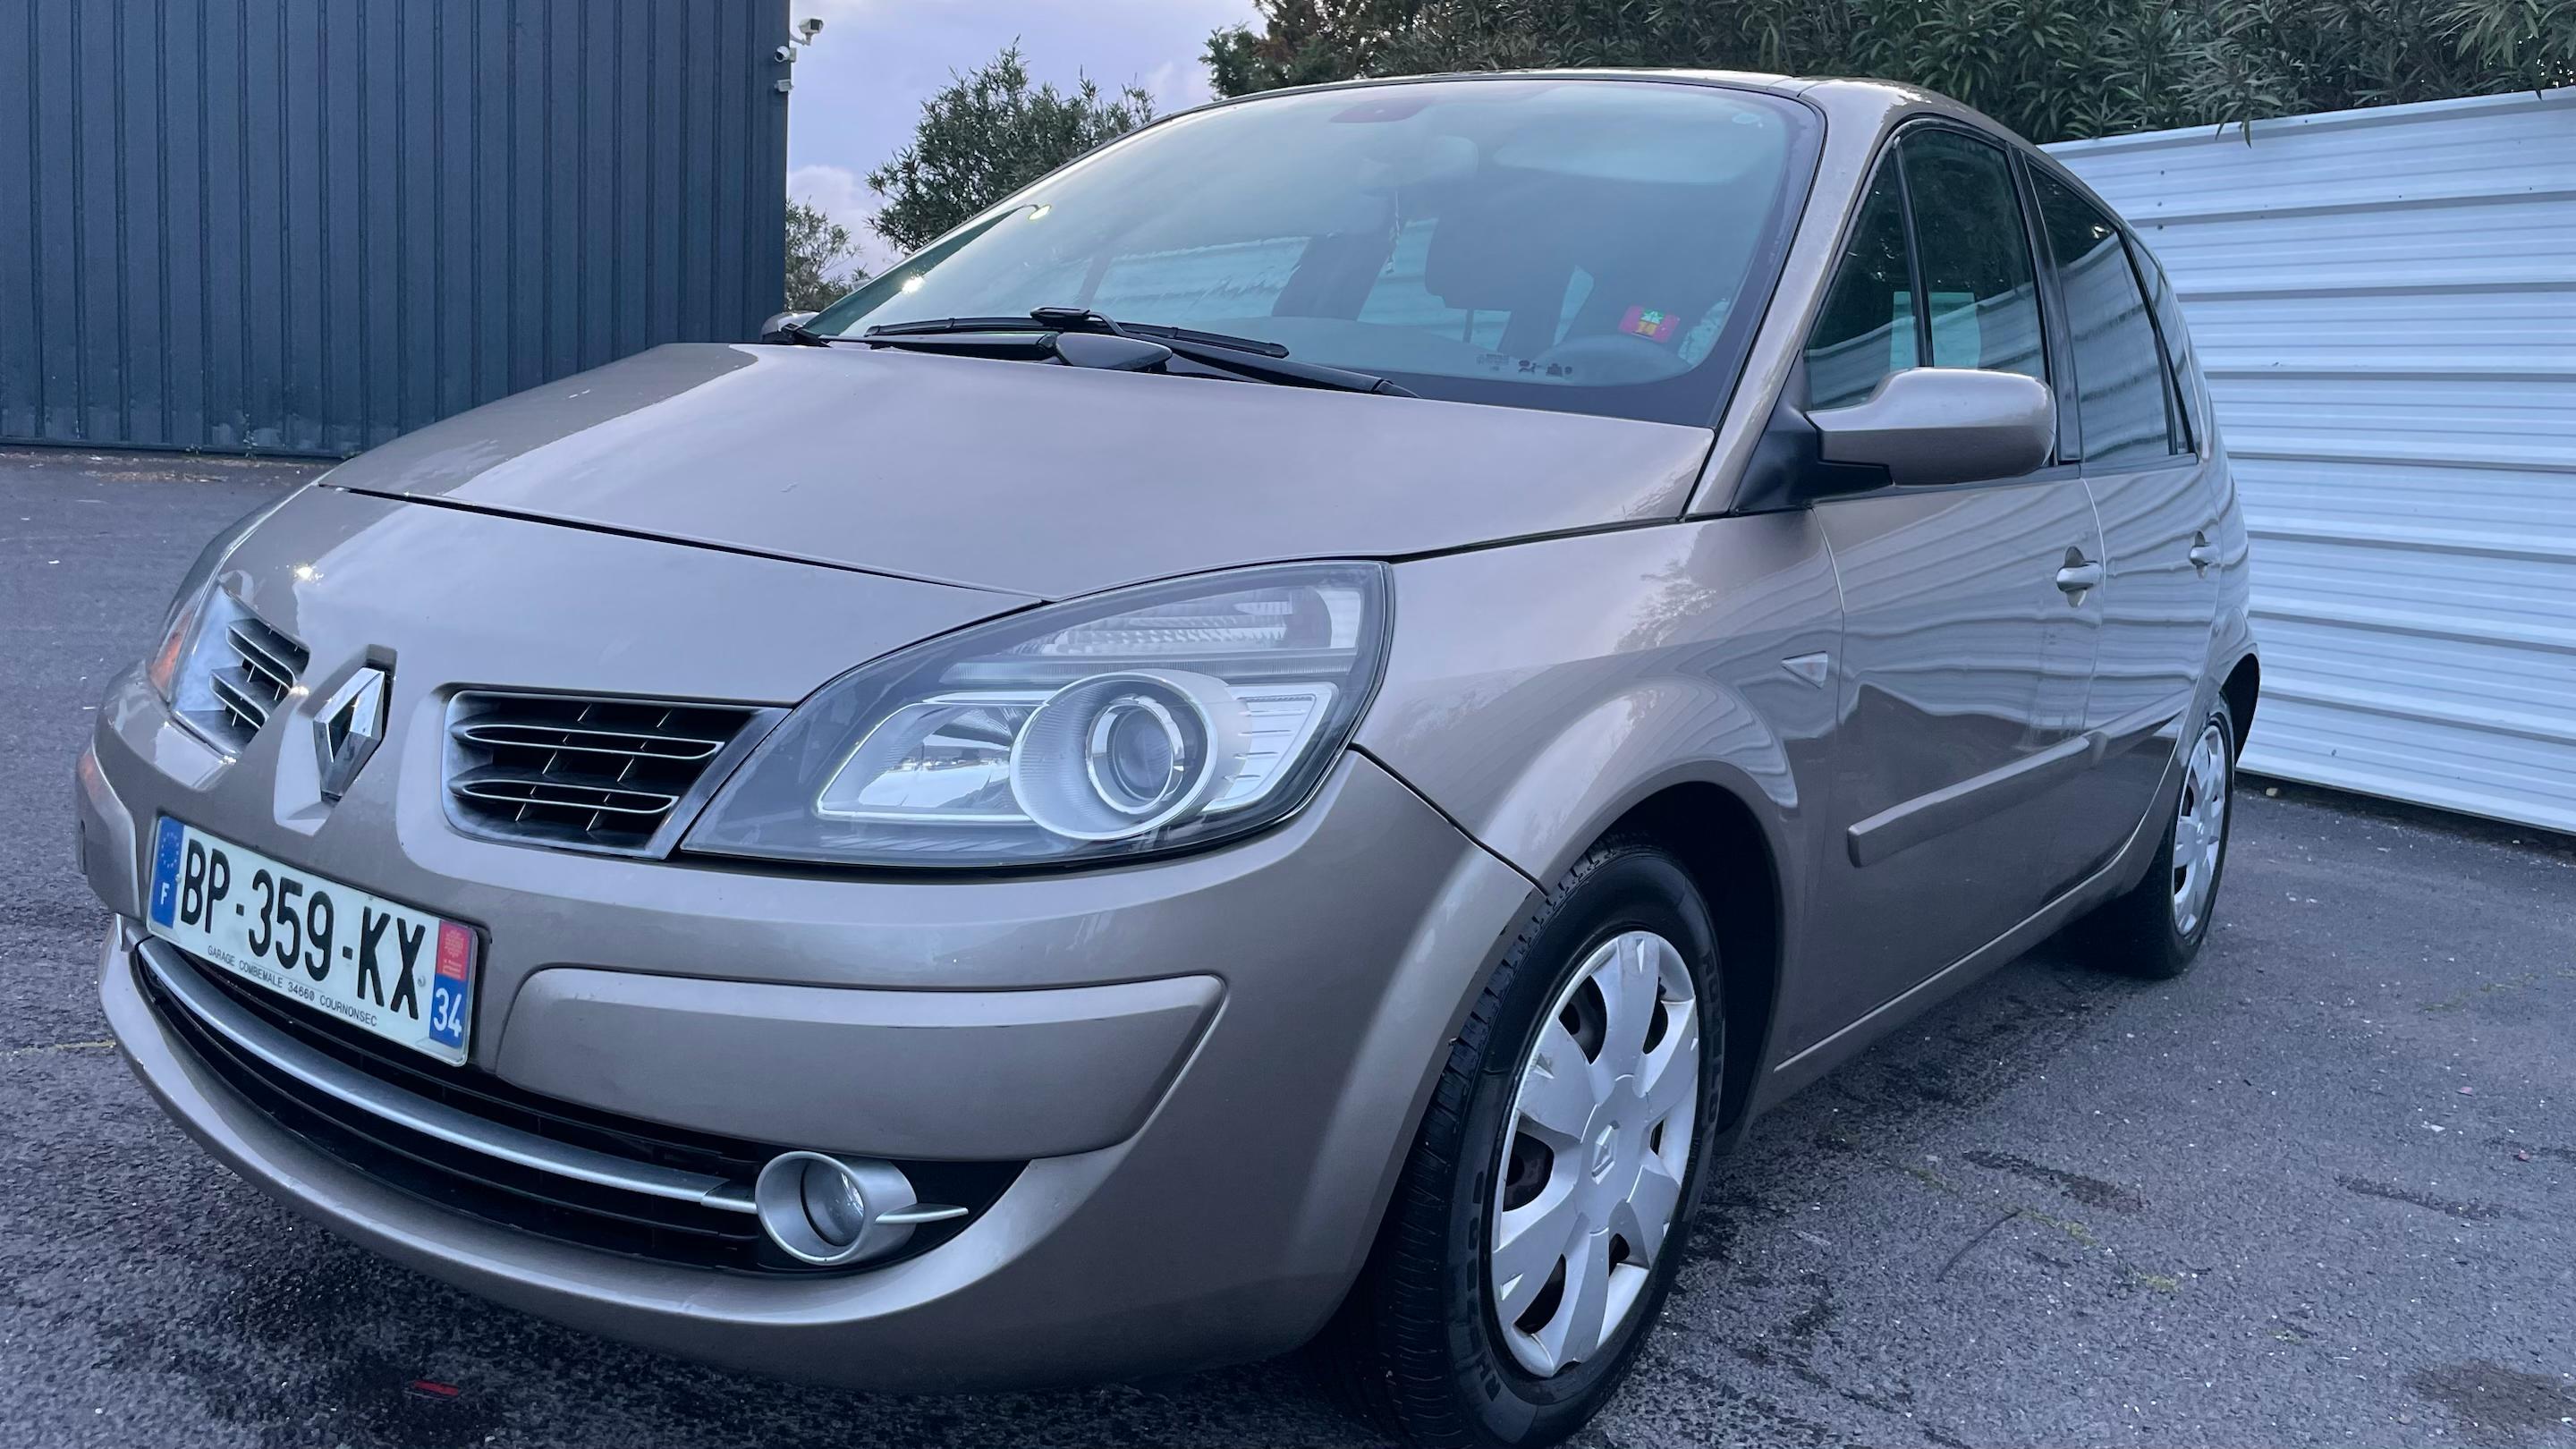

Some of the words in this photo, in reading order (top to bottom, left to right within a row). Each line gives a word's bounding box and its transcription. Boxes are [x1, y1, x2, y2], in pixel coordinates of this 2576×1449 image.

[160, 881, 170, 906] F
[180, 838, 426, 1021] BP-359-KX
[208, 945, 235, 966] GARAGE
[239, 960, 283, 988] COMBEMALE
[287, 981, 315, 1002] 34660
[319, 994, 377, 1027] COURNONSEC
[433, 987, 462, 1038] 34
